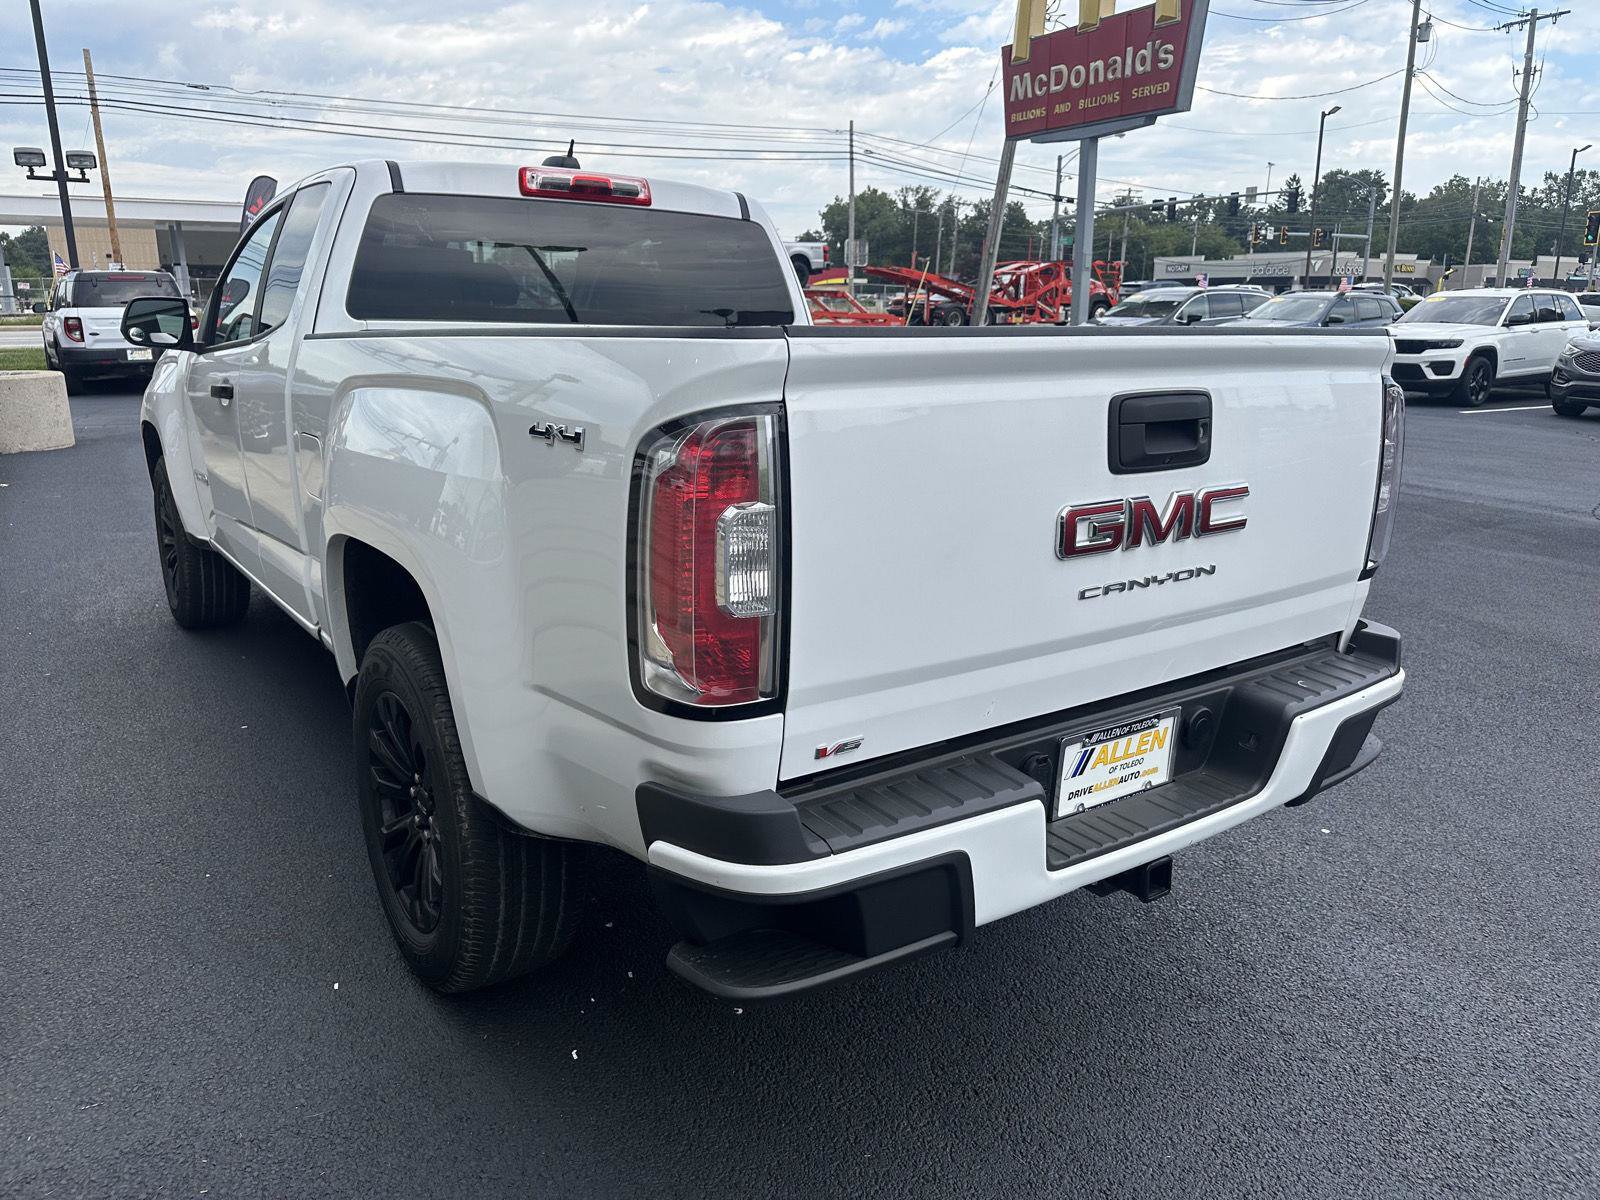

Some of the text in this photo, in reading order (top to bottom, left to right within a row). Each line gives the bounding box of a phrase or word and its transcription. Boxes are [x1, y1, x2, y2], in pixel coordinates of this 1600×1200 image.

[1010, 40, 1175, 102] McDonald's
[1010, 81, 1170, 123] BILLIONS AND BILLIONS SERVED
[1055, 482, 1250, 561] GMC
[1078, 564, 1216, 601] CANYON
[814, 735, 864, 760] V6
[1091, 726, 1169, 770] ALLEN
[1098, 719, 1157, 741] ALLEN OF TOLEDO
[1108, 757, 1144, 775] OF TOLEDO
